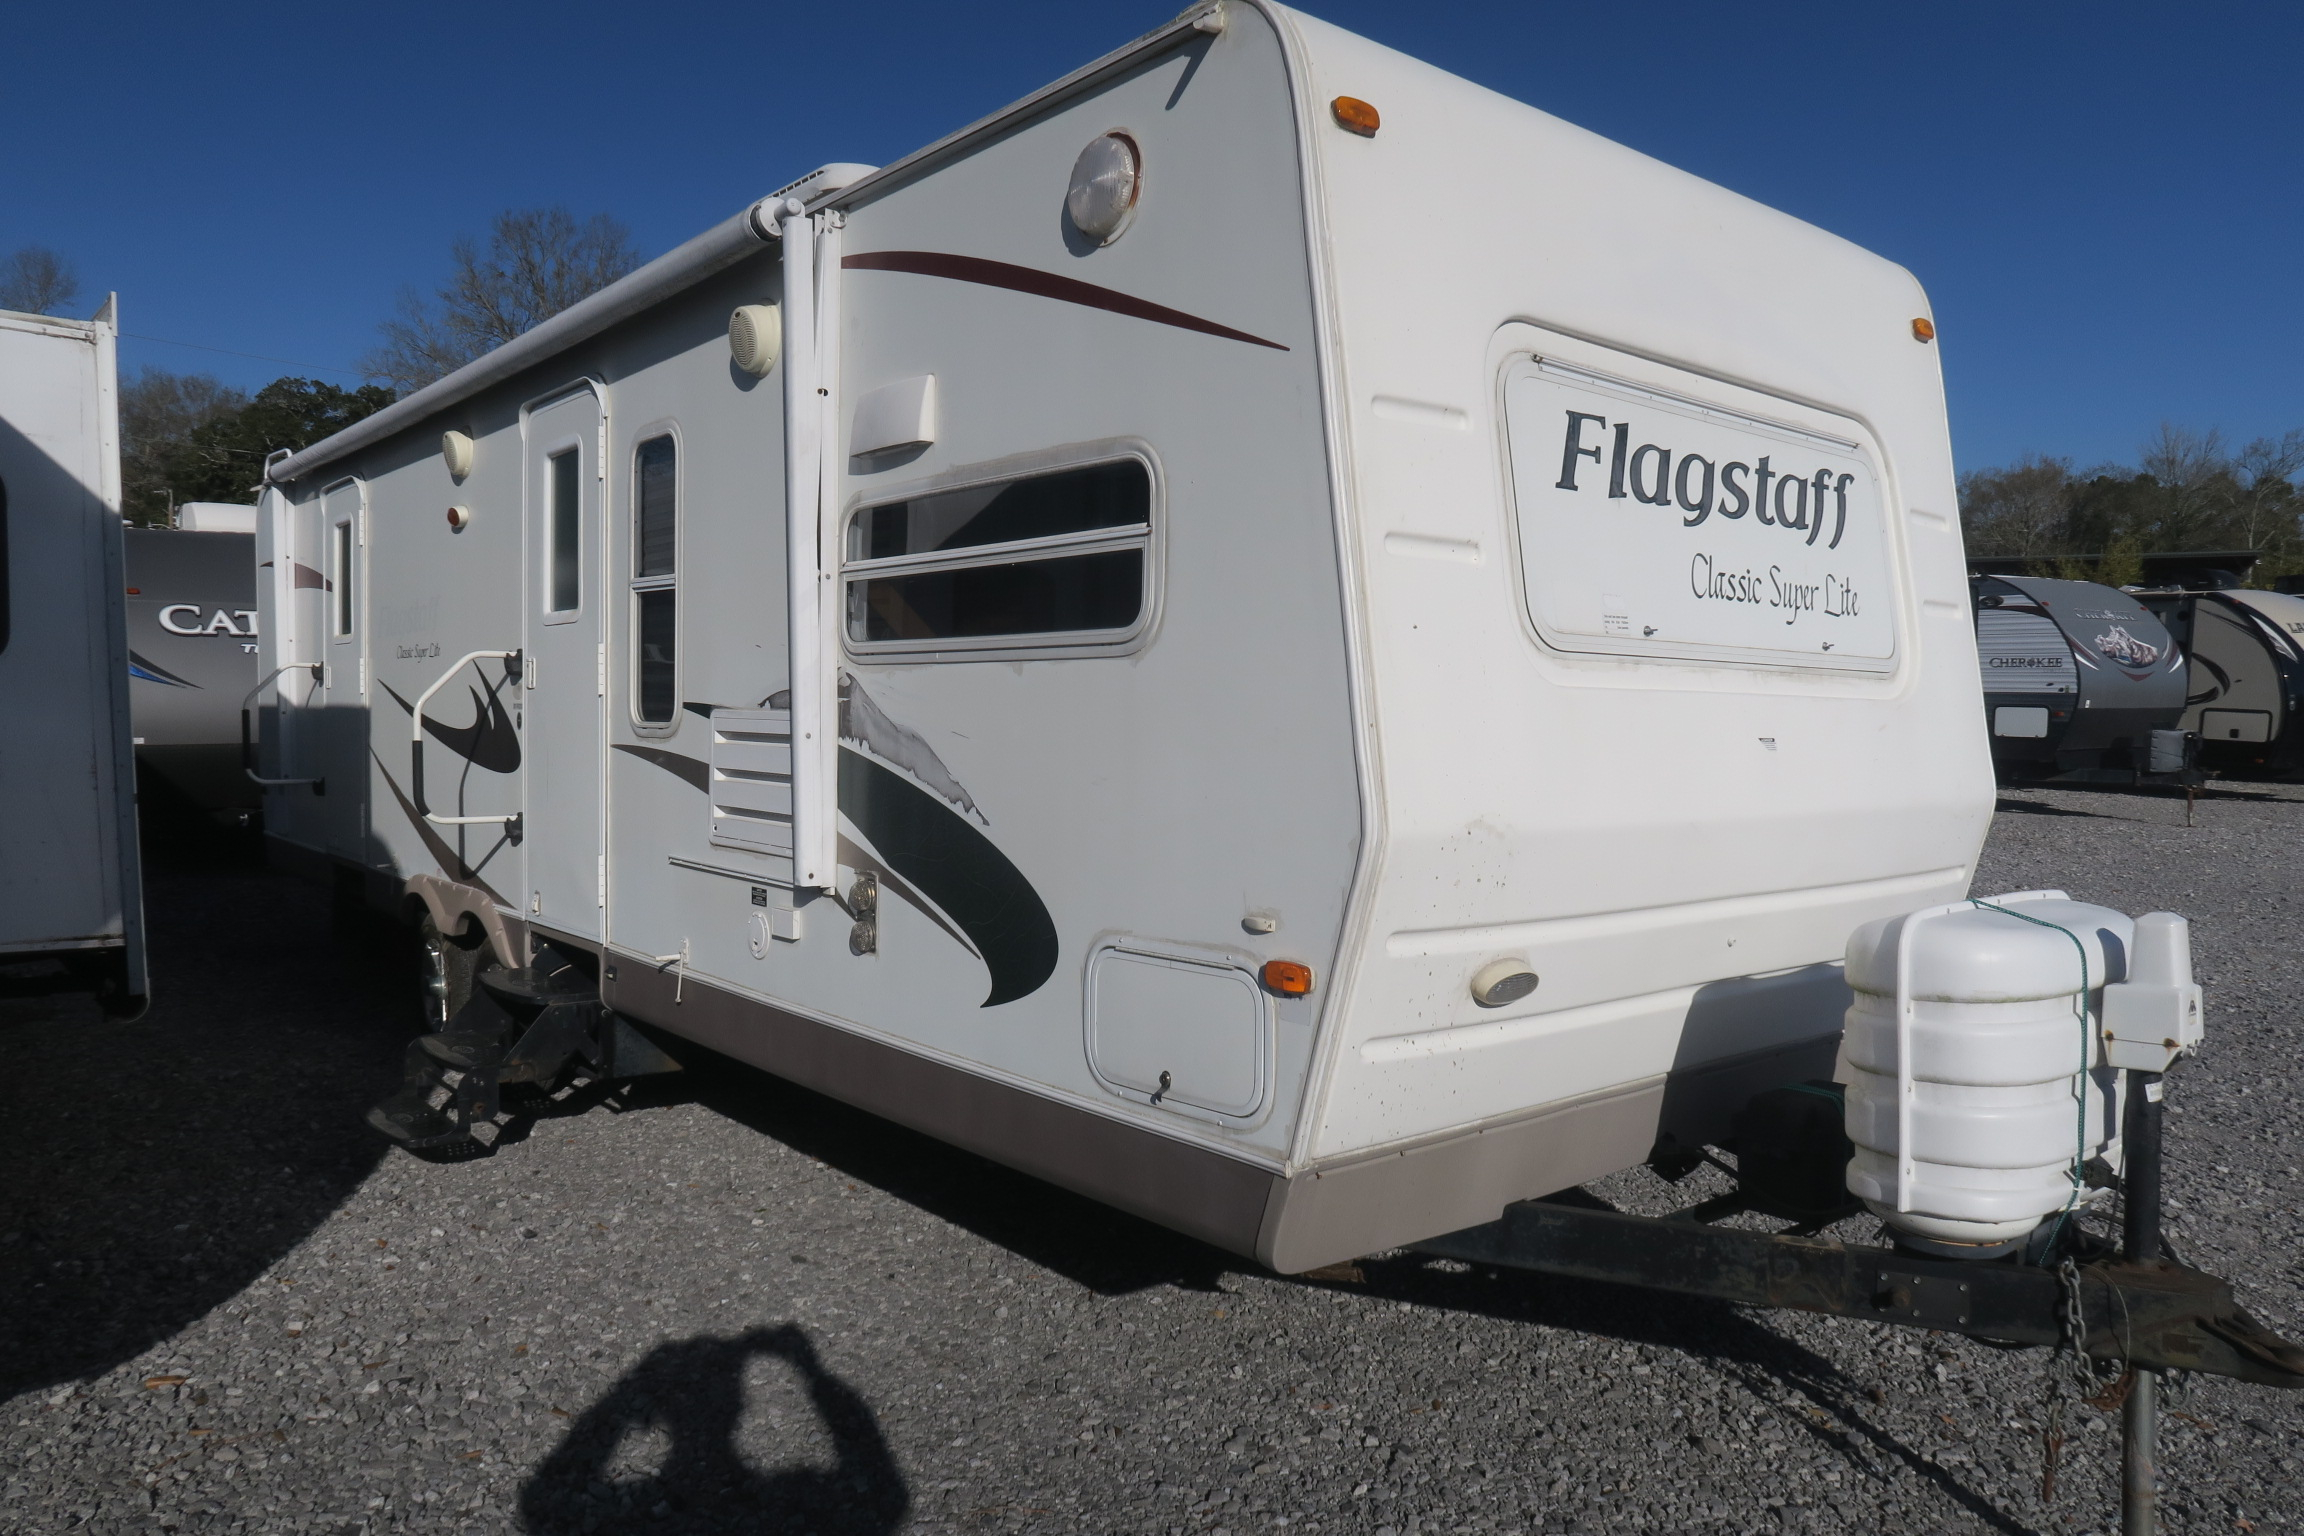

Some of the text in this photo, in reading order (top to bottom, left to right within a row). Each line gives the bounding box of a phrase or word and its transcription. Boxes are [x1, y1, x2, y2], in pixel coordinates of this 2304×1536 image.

[1555, 409, 1855, 550] Flagstaff
[1691, 553, 1861, 625] Classic Super Lite
